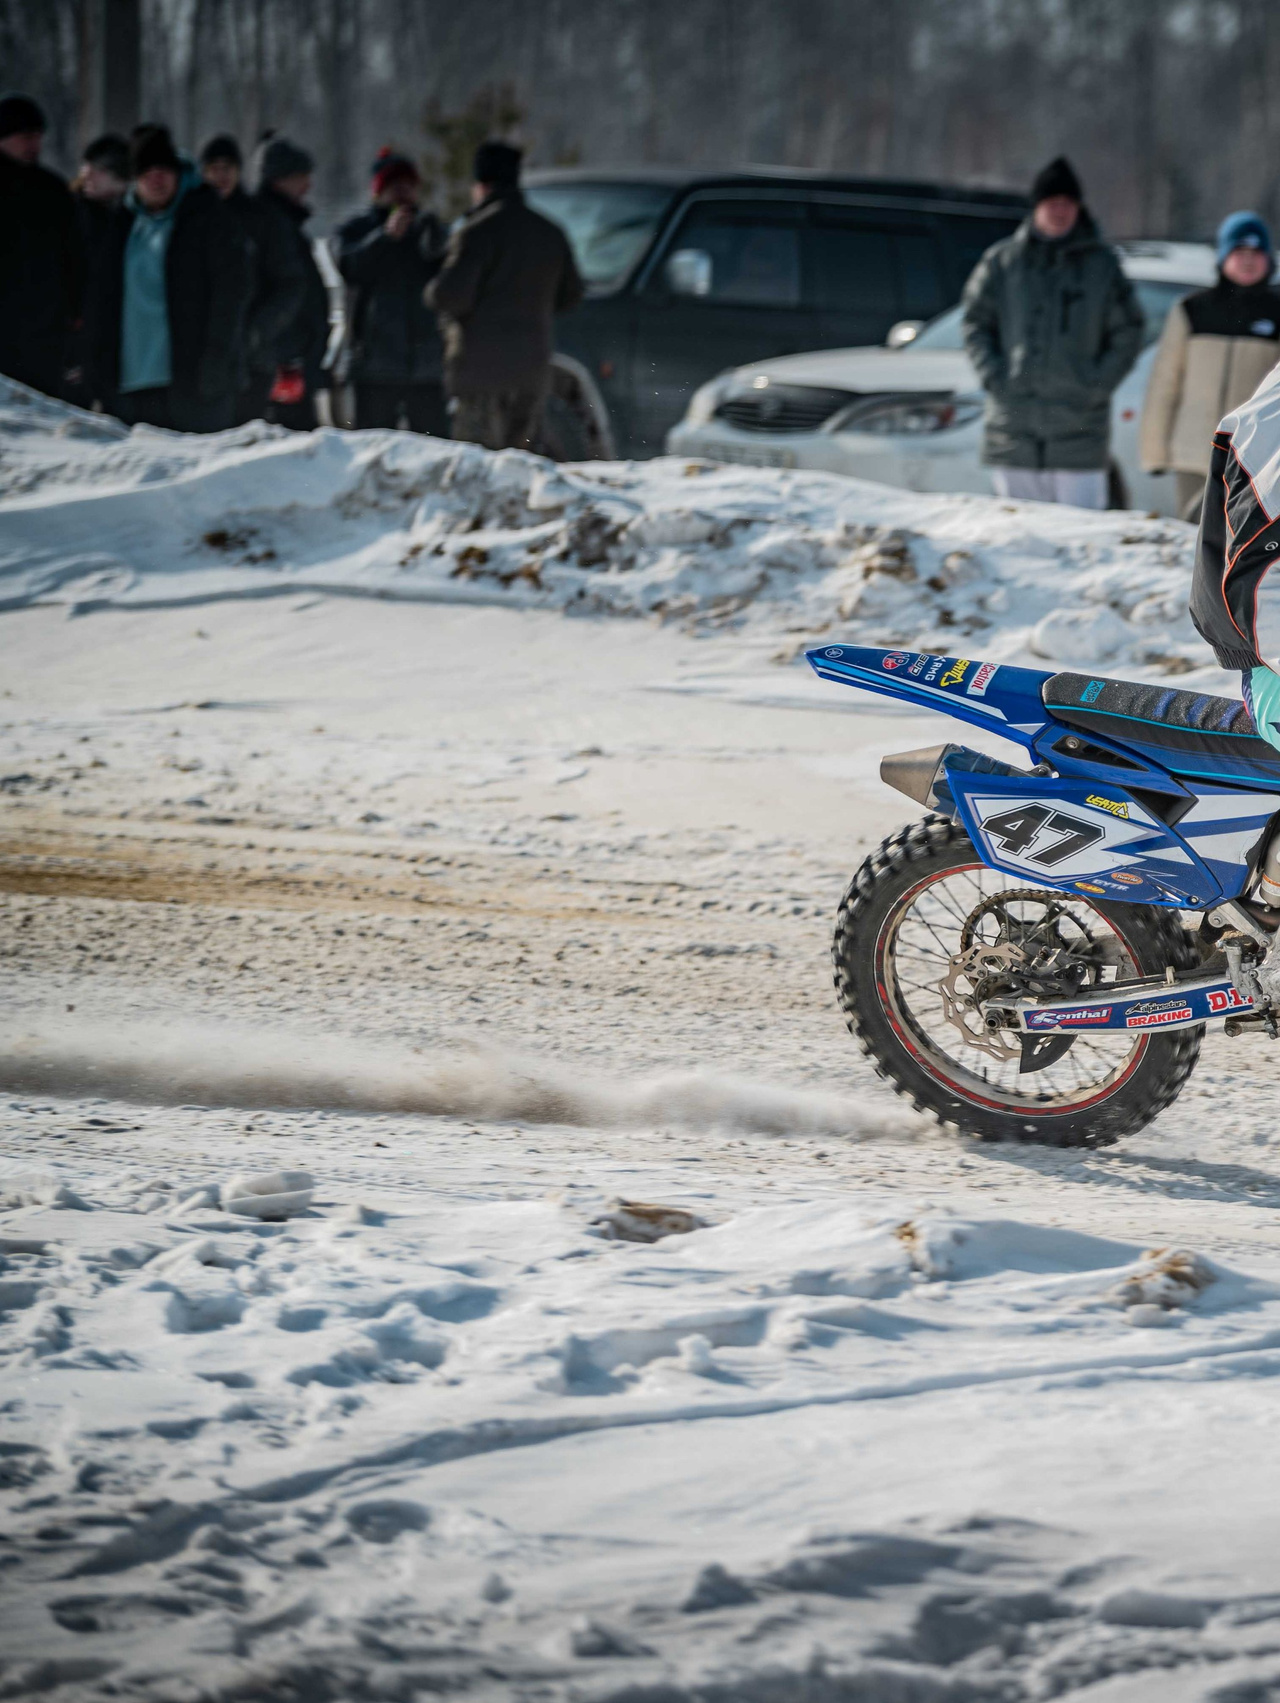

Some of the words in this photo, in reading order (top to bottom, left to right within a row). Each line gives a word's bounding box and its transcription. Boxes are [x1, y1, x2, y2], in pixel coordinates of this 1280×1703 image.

[942, 659, 970, 684] EATT
[971, 663, 996, 690] Castrol
[978, 801, 1106, 868] 47
[1031, 1009, 1109, 1024] Renthal
[1127, 1009, 1191, 1026] BRAKING
[1139, 1000, 1187, 1014] alpinestars
